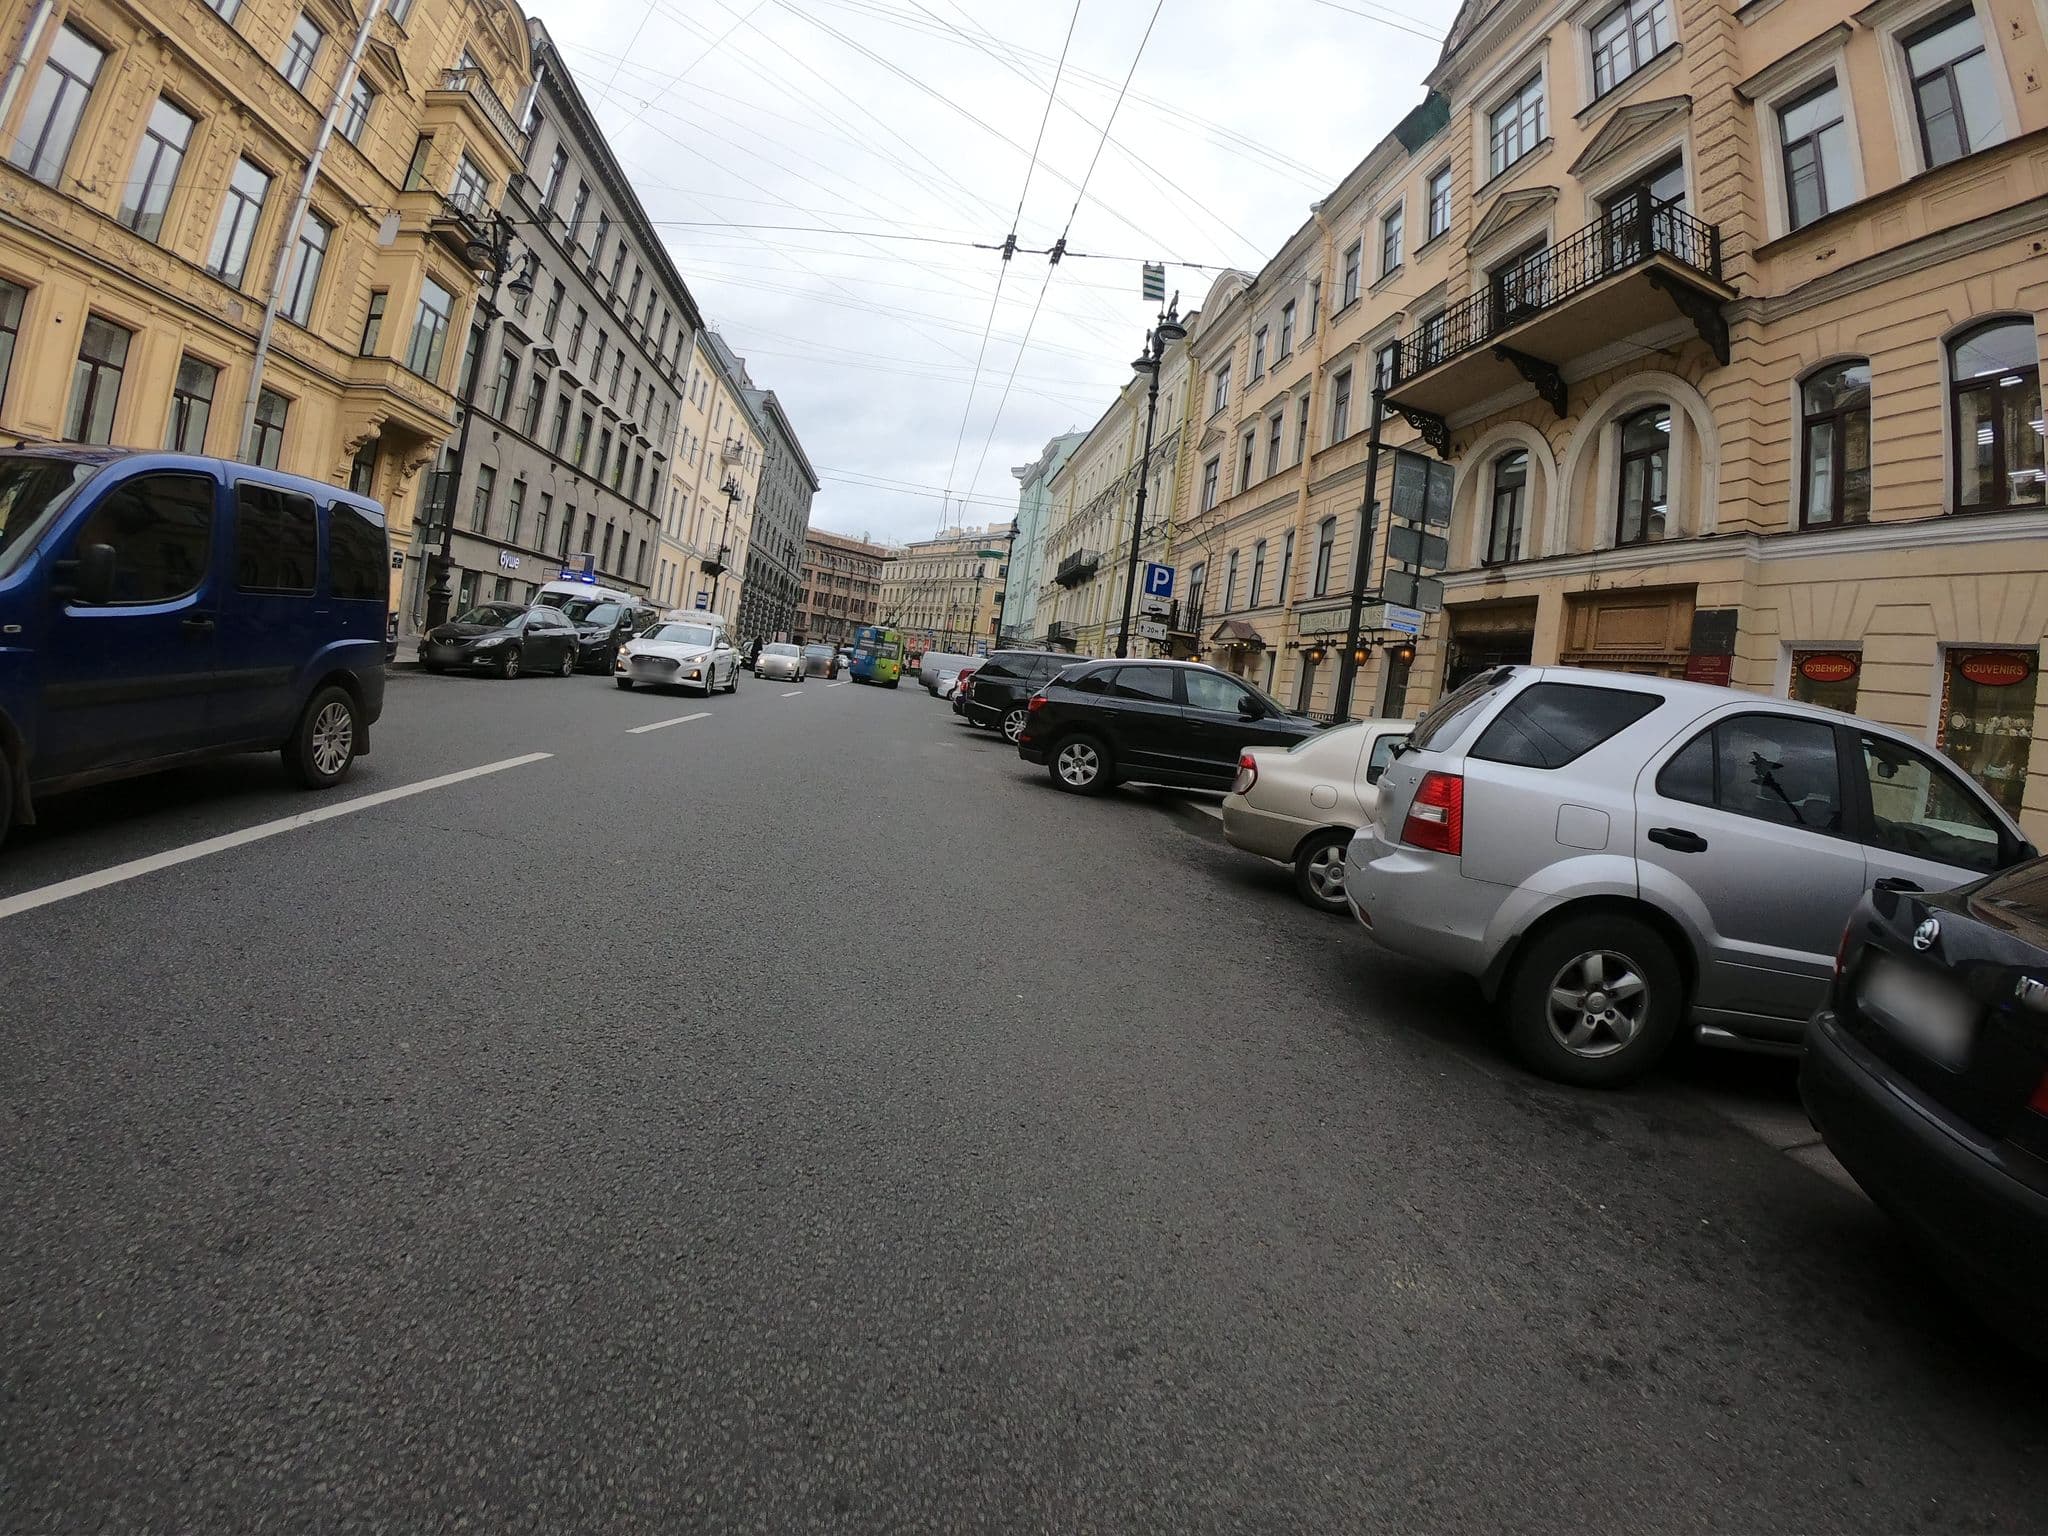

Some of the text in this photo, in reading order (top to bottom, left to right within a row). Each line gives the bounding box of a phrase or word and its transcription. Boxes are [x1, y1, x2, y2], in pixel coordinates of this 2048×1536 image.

[500, 550, 520, 569] буше
[1152, 567, 1170, 592] P
[1804, 663, 1853, 673] СУВЕНИРЫ
[1964, 663, 2023, 675] SOUVENIRS
